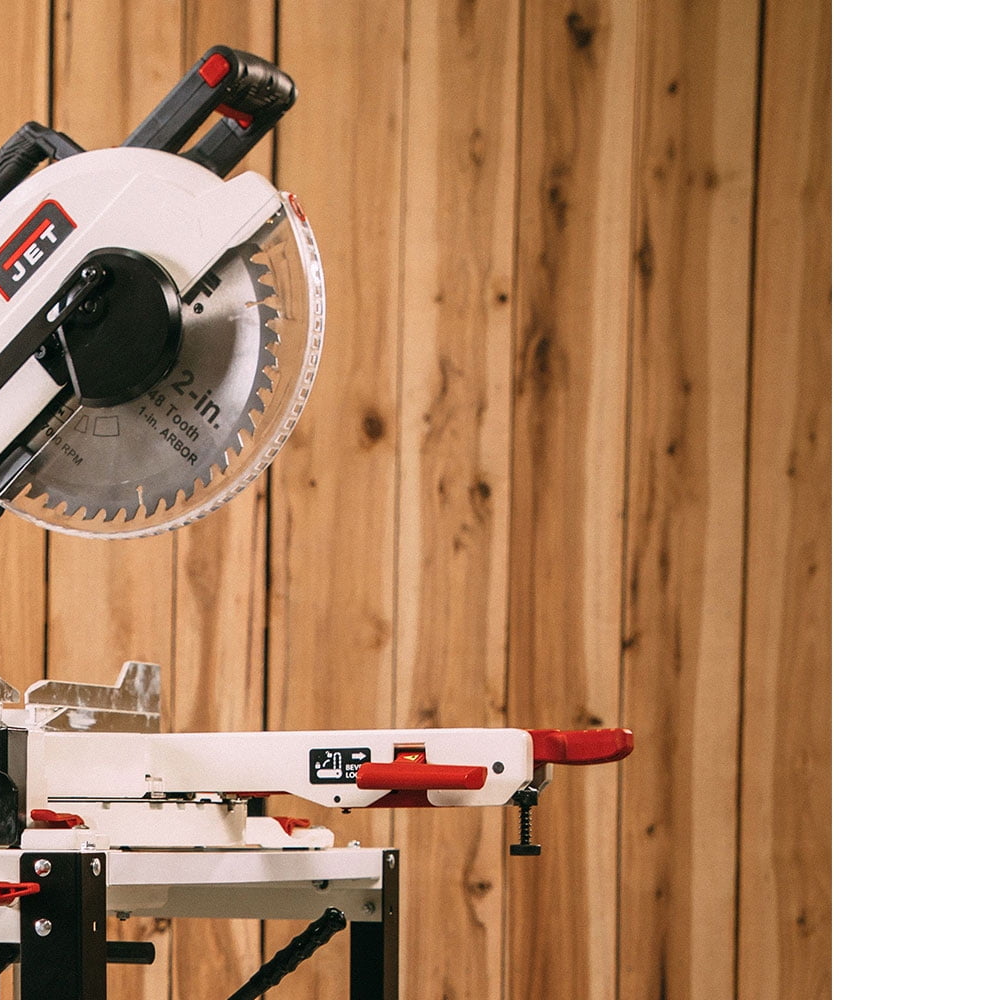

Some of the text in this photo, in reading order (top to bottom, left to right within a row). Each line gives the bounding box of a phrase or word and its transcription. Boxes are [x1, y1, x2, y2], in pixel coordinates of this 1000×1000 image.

[11, 223, 58, 282] JET
[138, 406, 198, 466] 1-in. ARBOR
[148, 390, 200, 442] 48 Tooth
[61, 442, 84, 466] RPM
